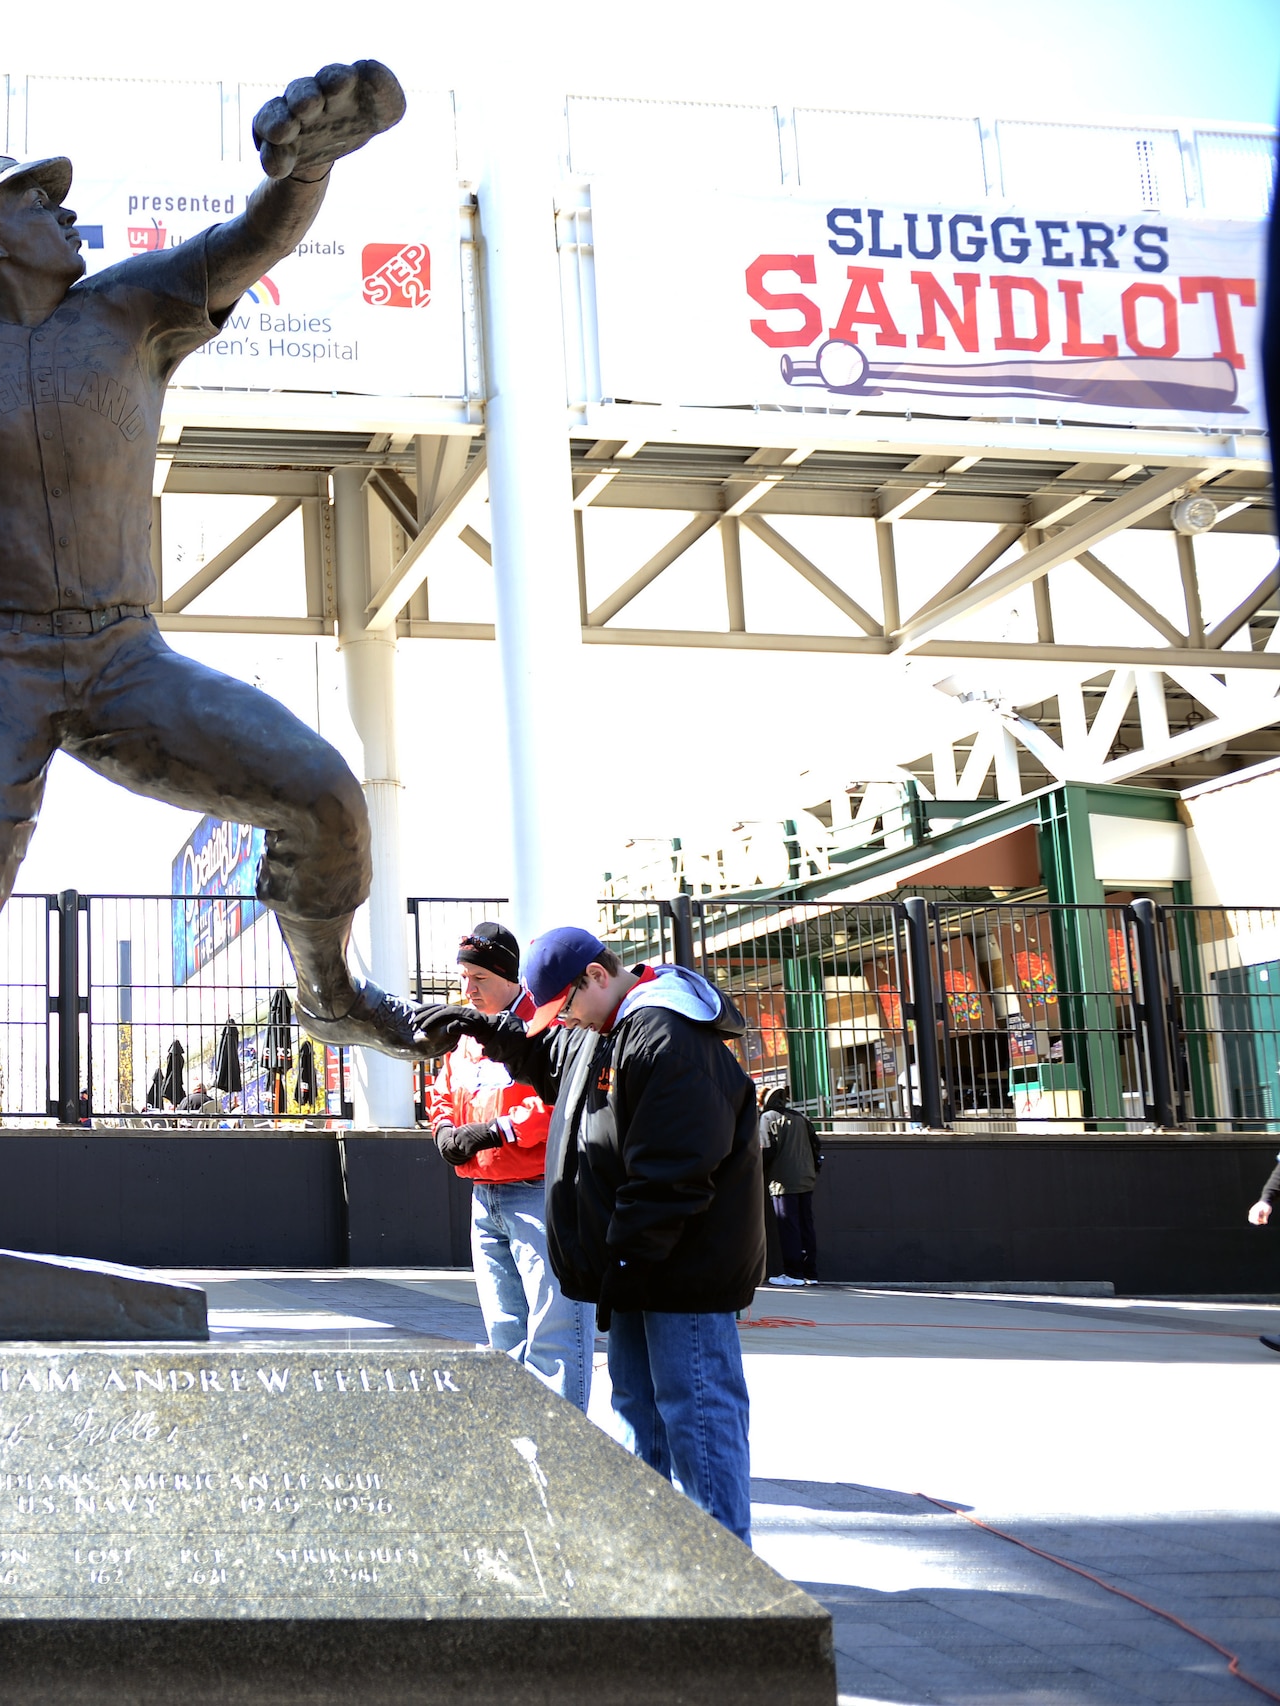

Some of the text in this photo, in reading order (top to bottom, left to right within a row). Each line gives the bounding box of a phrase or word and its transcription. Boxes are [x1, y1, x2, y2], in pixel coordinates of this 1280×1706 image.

[128, 194, 234, 215] presented
[826, 207, 1170, 273] SLUGGER'S
[363, 243, 426, 305] STEP
[260, 312, 332, 334] Babies
[745, 254, 1257, 370] SANDLOT
[269, 338, 359, 363] Hospital
[103, 1367, 290, 1392] ANDREW
[113, 1472, 270, 1492] AMERICAN
[74, 1495, 160, 1514] NAVY
